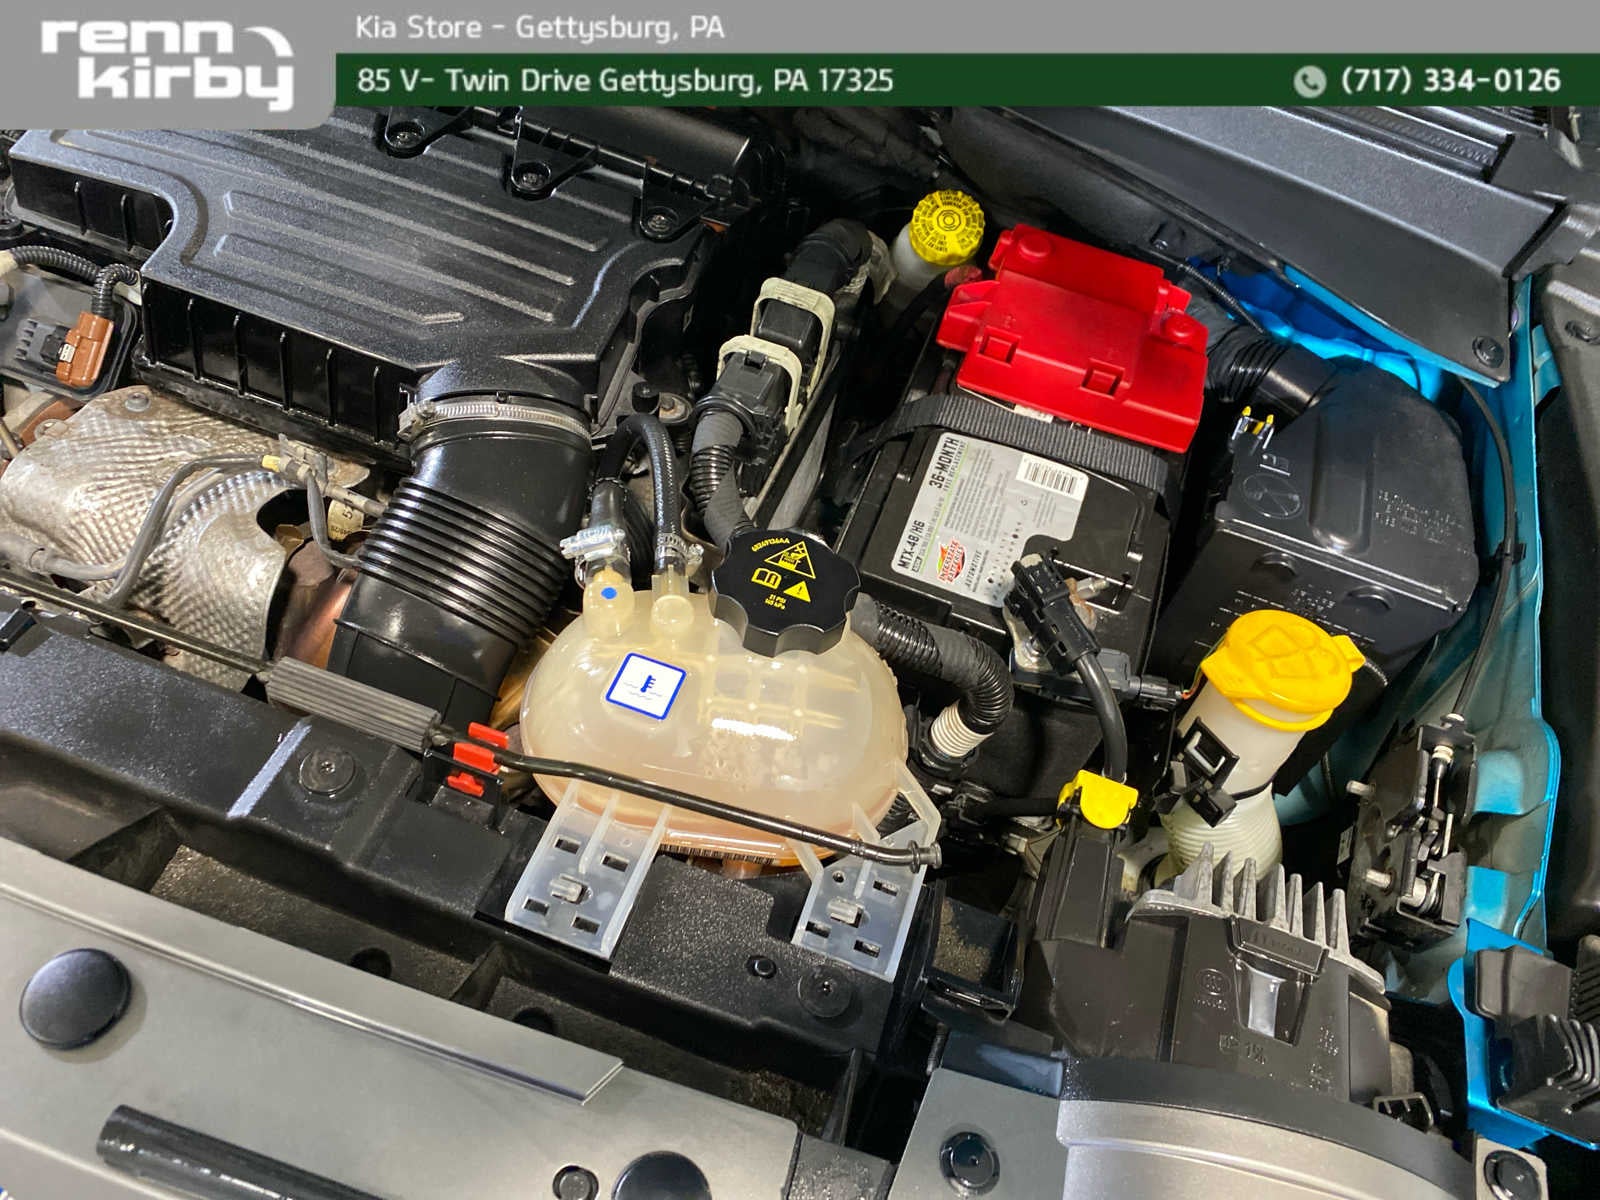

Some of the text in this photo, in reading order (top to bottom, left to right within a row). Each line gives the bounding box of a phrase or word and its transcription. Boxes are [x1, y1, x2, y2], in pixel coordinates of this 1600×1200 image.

[929, 436, 960, 489] 36-MONTH
[938, 539, 960, 582] INTERSTATE
[946, 545, 964, 583] BATTERIES
